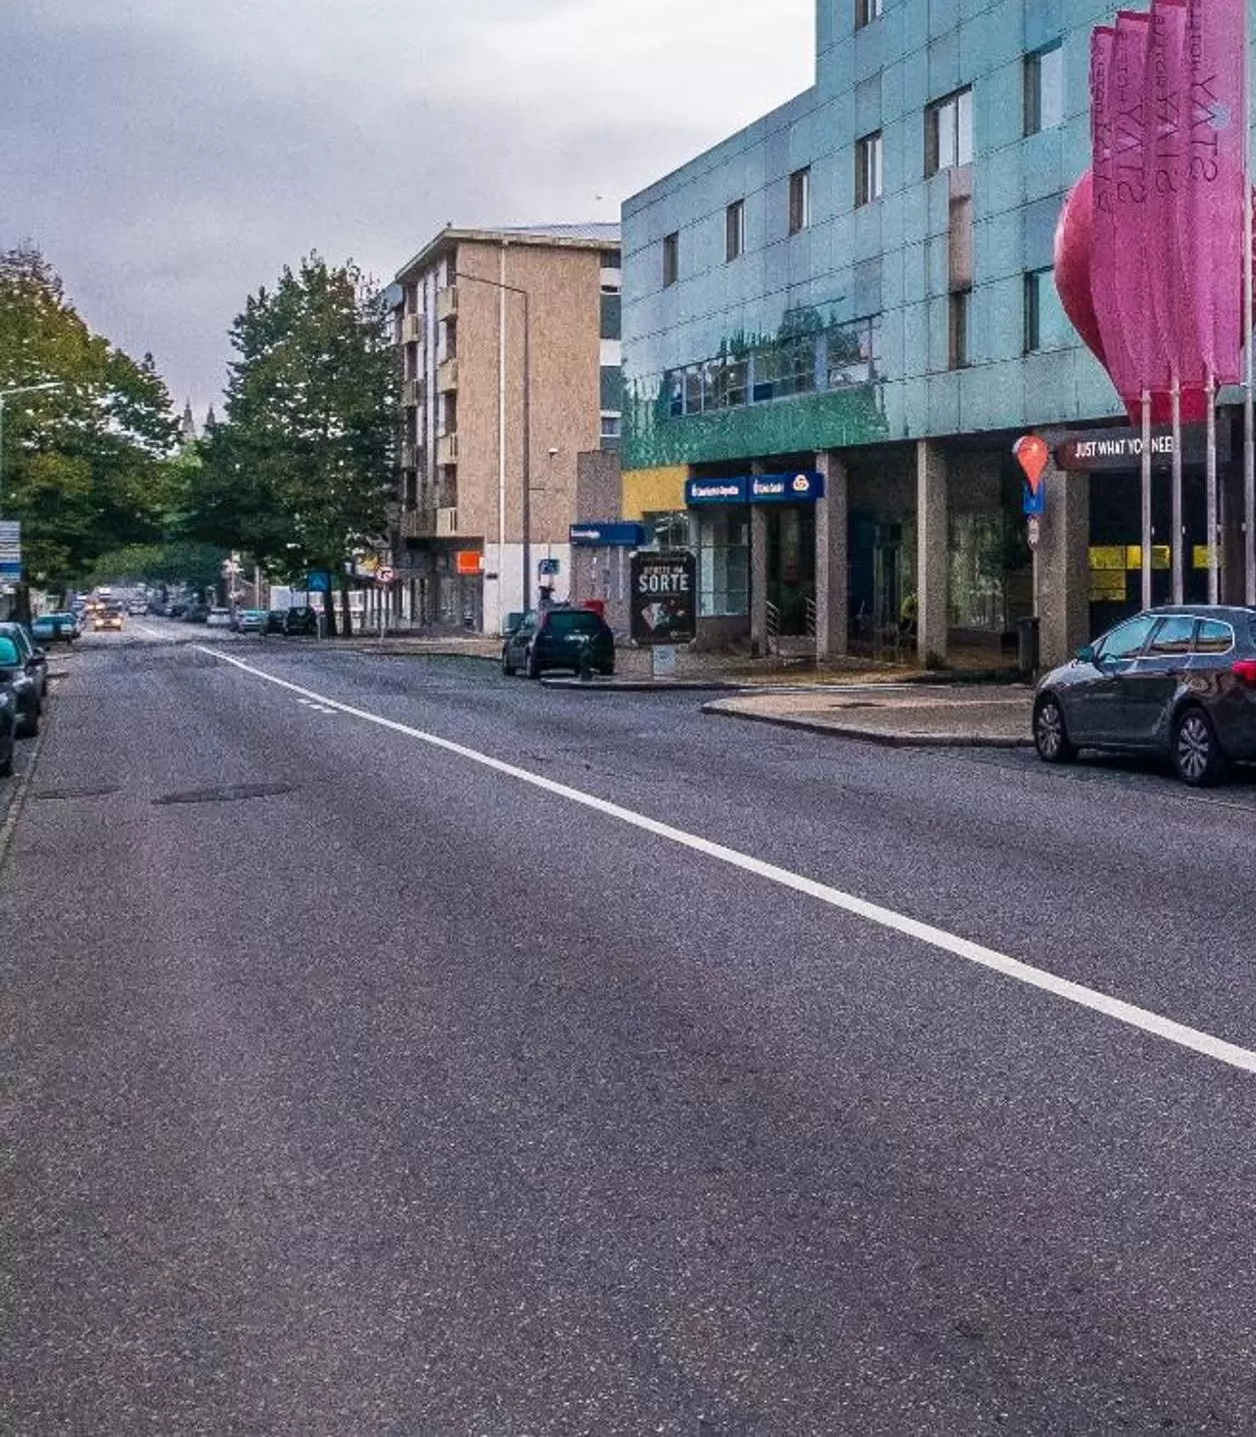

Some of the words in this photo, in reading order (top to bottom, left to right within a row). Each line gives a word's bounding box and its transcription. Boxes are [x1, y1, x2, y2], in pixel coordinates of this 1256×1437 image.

[1075, 442, 1097, 458] JUST
[1098, 440, 1126, 456] WHAT
[1126, 438, 1143, 454] YO
[1151, 436, 1173, 453] NEE
[639, 574, 689, 592] SORTE
